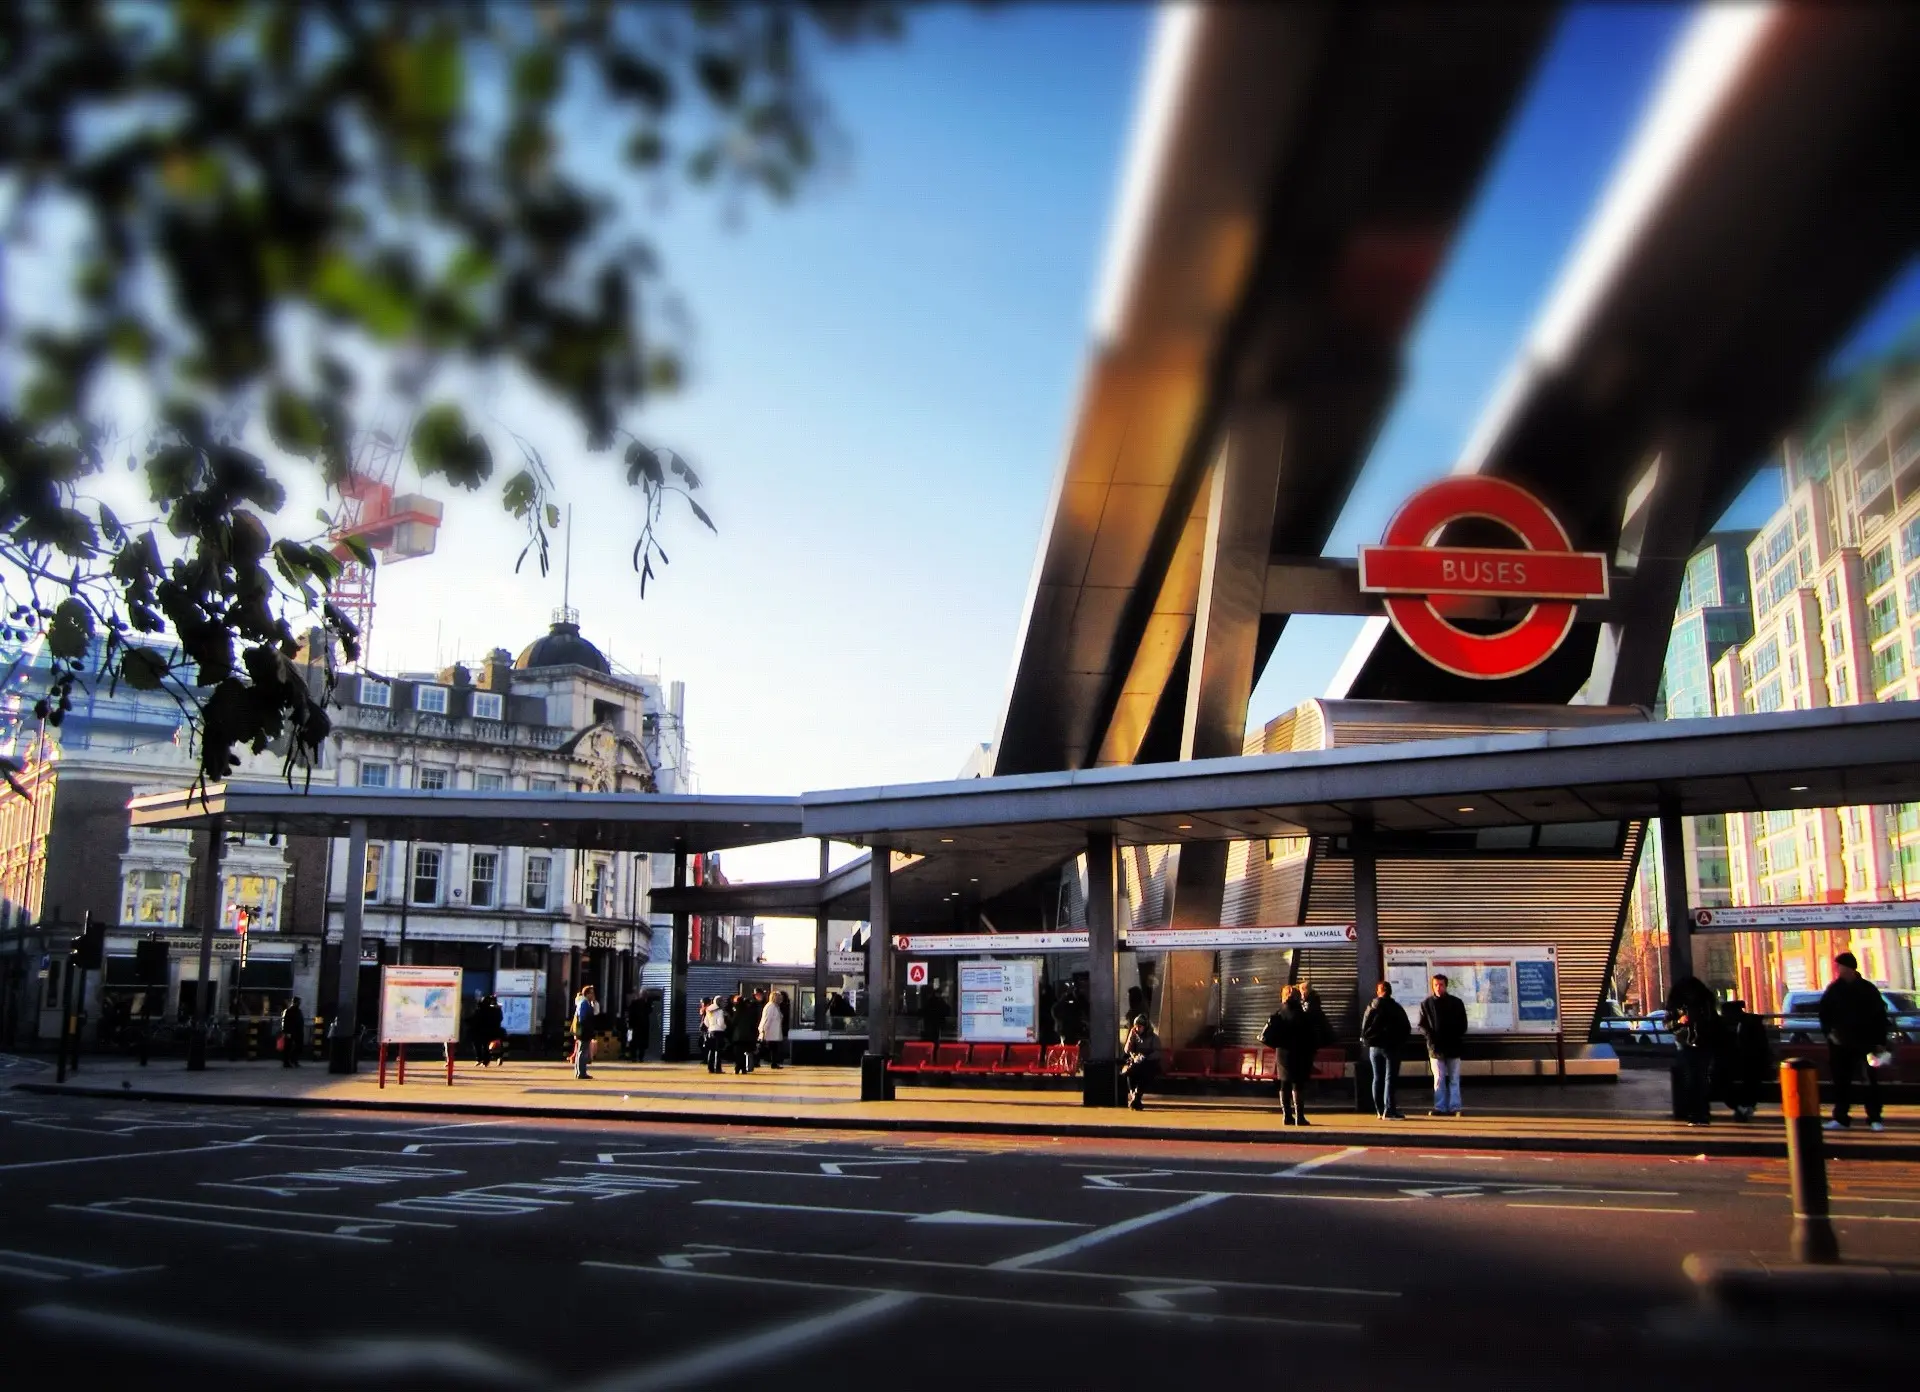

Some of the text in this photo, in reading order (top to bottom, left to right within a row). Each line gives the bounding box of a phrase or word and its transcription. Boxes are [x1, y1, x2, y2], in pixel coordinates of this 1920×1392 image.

[1442, 560, 1528, 584] BUSES
[590, 930, 604, 938] THE
[1304, 929, 1342, 938] VAUXHALL
[588, 936, 617, 949] ISSUE
[1062, 936, 1089, 944] VAUXHA
